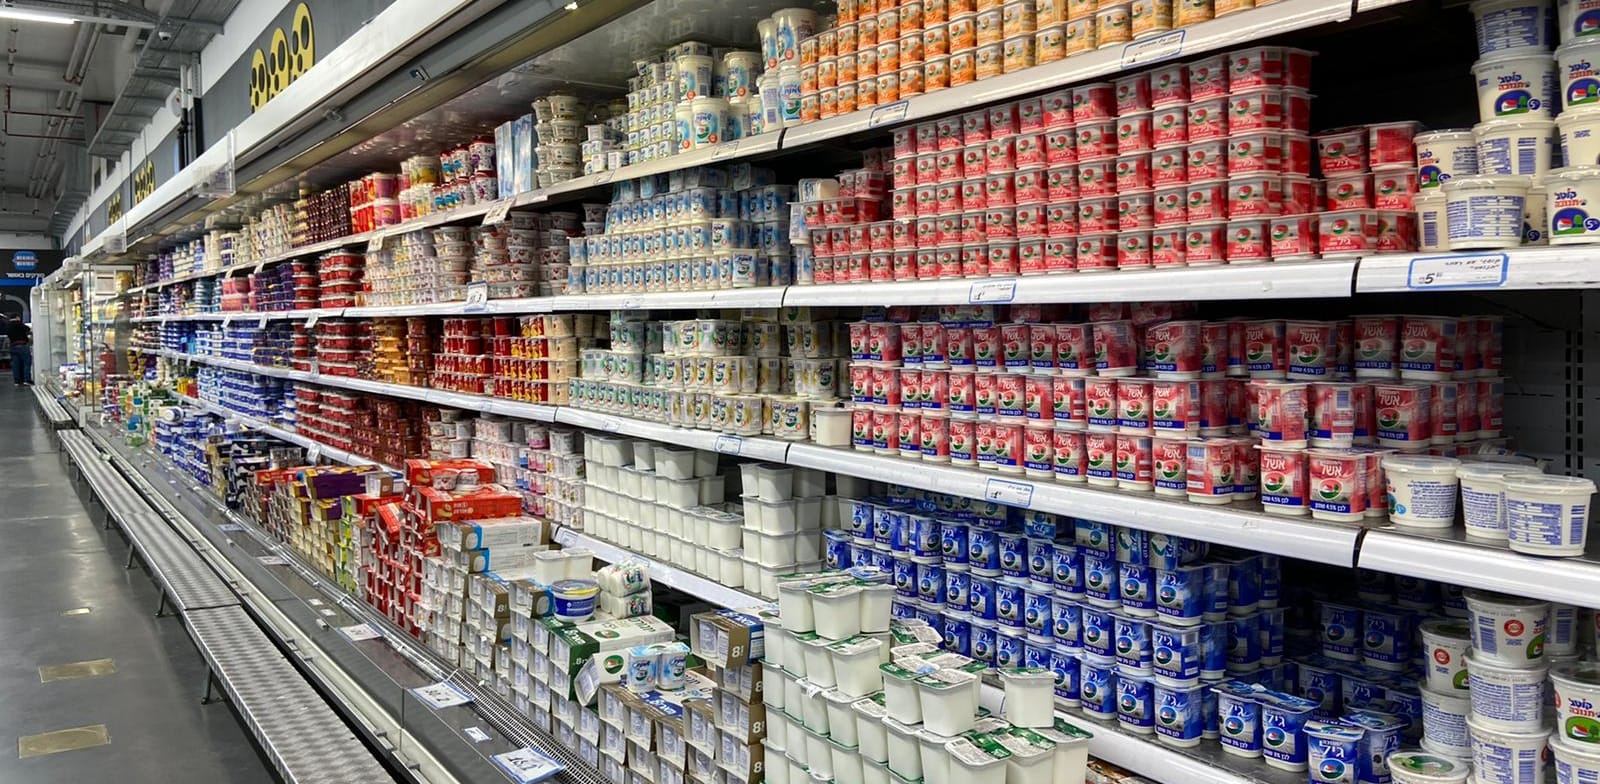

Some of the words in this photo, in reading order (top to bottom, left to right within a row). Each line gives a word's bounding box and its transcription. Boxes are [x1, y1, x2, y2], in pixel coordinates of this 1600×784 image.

[1380, 392, 1400, 405] אשל
[1264, 455, 1285, 470] אשל
[1321, 460, 1342, 476] אשל
[1057, 551, 1070, 563] גיל
[1126, 565, 1140, 577] גיל
[1088, 615, 1100, 625] גיל
[1120, 624, 1132, 636] גיל
[1158, 635, 1172, 646] גיל
[732, 646, 740, 658] 8
[1054, 657, 1066, 668] גיל
[1087, 670, 1099, 681] גיל
[1123, 681, 1137, 694] גיל
[1162, 693, 1176, 705] גיל
[1229, 703, 1244, 716] גיל
[1268, 713, 1285, 727] גיל
[753, 722, 761, 733] 8
[1384, 734, 1398, 748] גיל
[1322, 743, 1344, 759] גיל
[753, 762, 761, 773] 8
